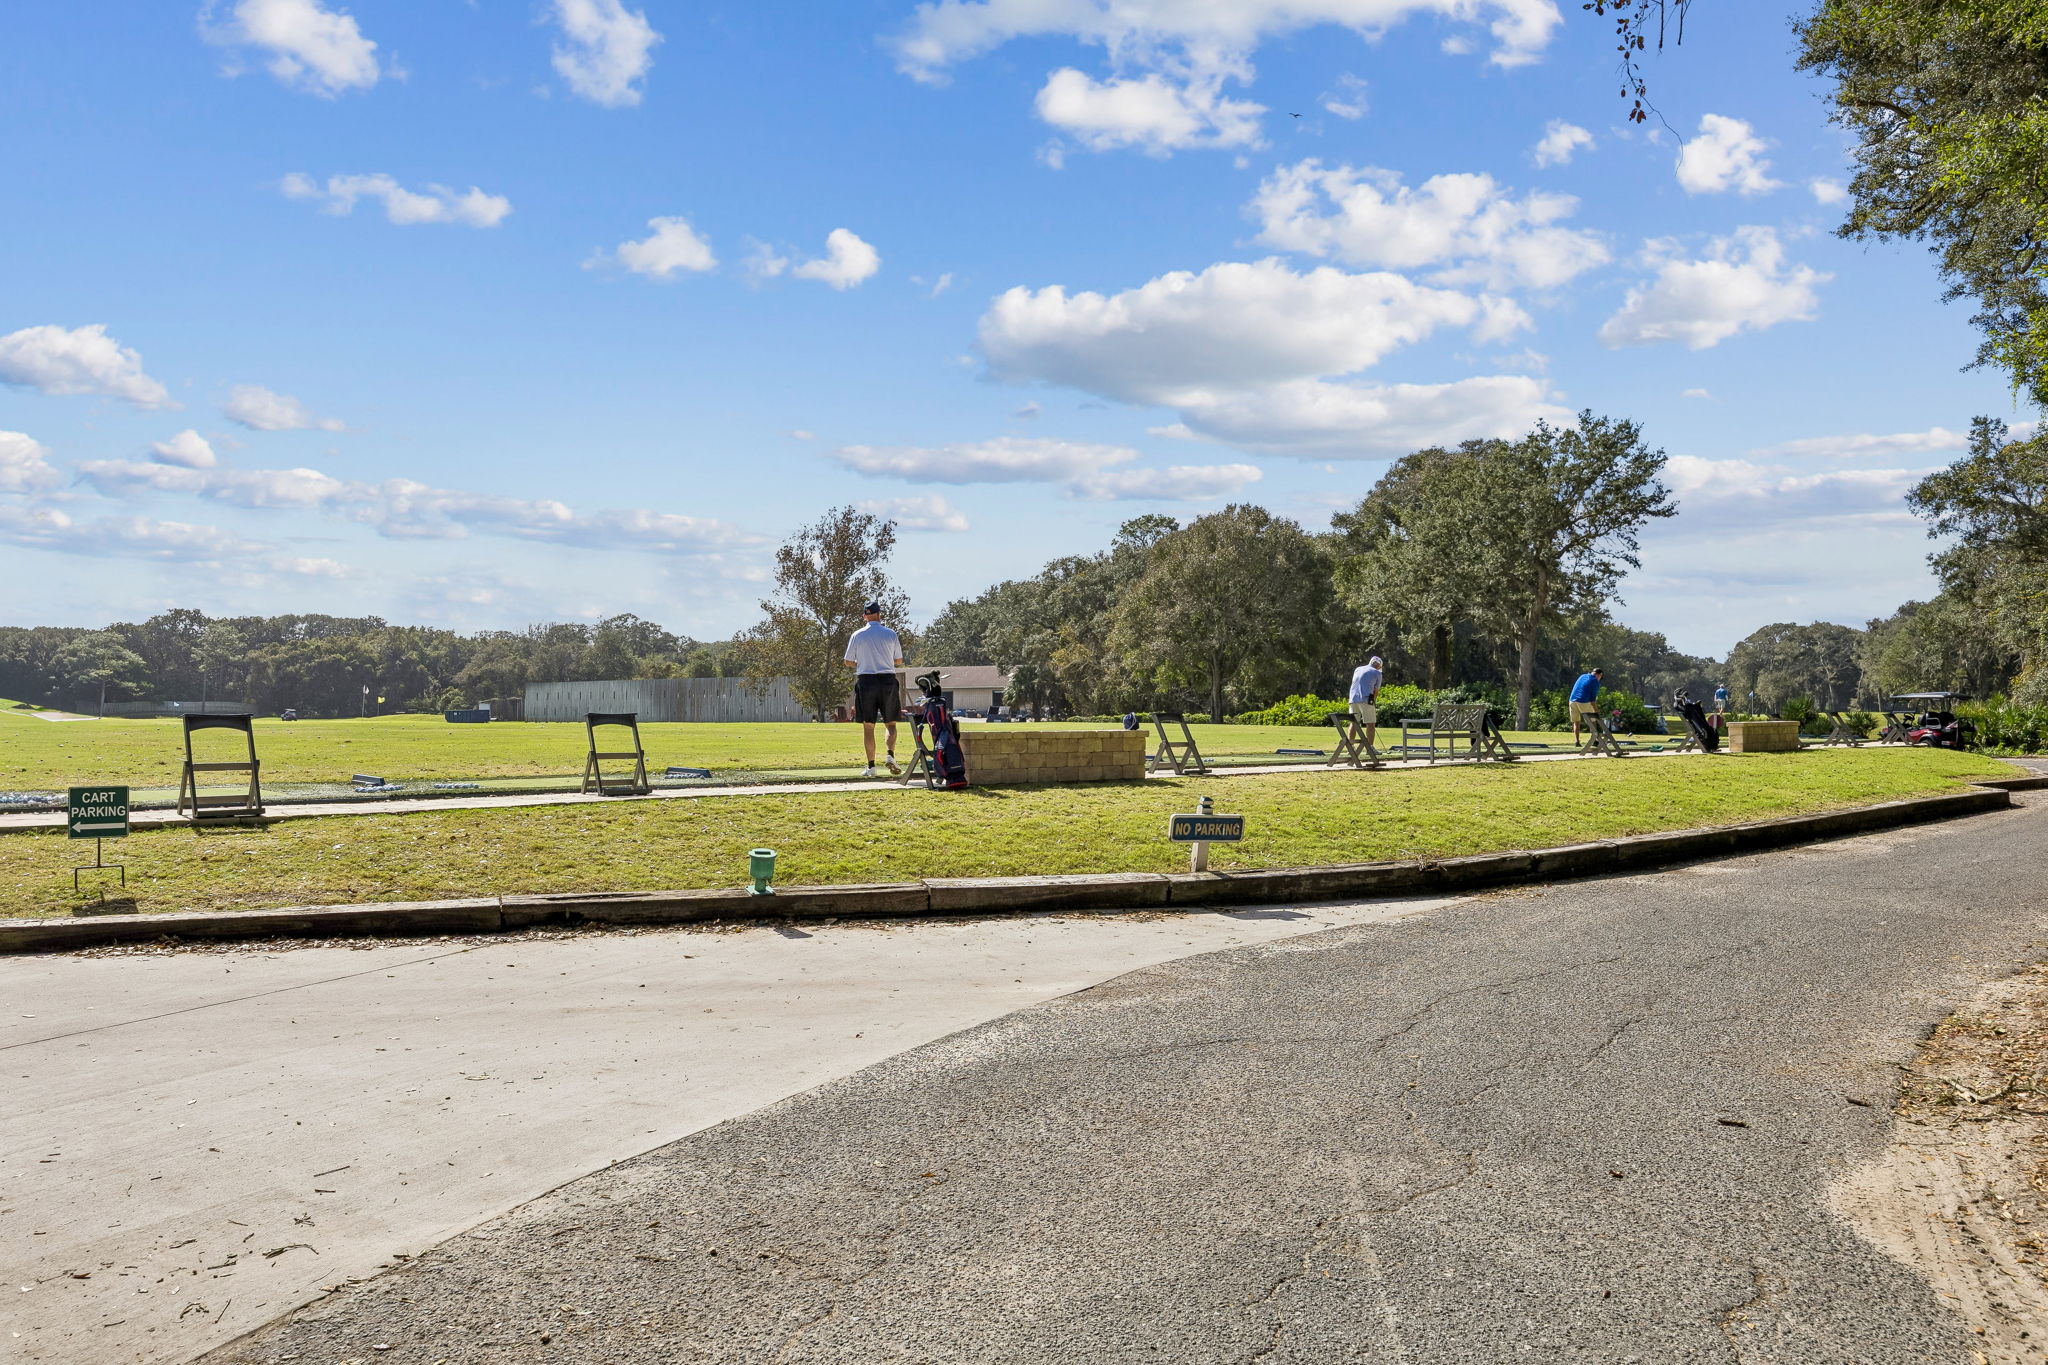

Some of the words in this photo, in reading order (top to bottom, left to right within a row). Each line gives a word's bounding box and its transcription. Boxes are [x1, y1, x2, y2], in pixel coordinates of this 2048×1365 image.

[82, 792, 116, 803] CART
[71, 806, 126, 818] PARKING
[1175, 823, 1191, 835] NO
[1195, 823, 1240, 836] PARKING
